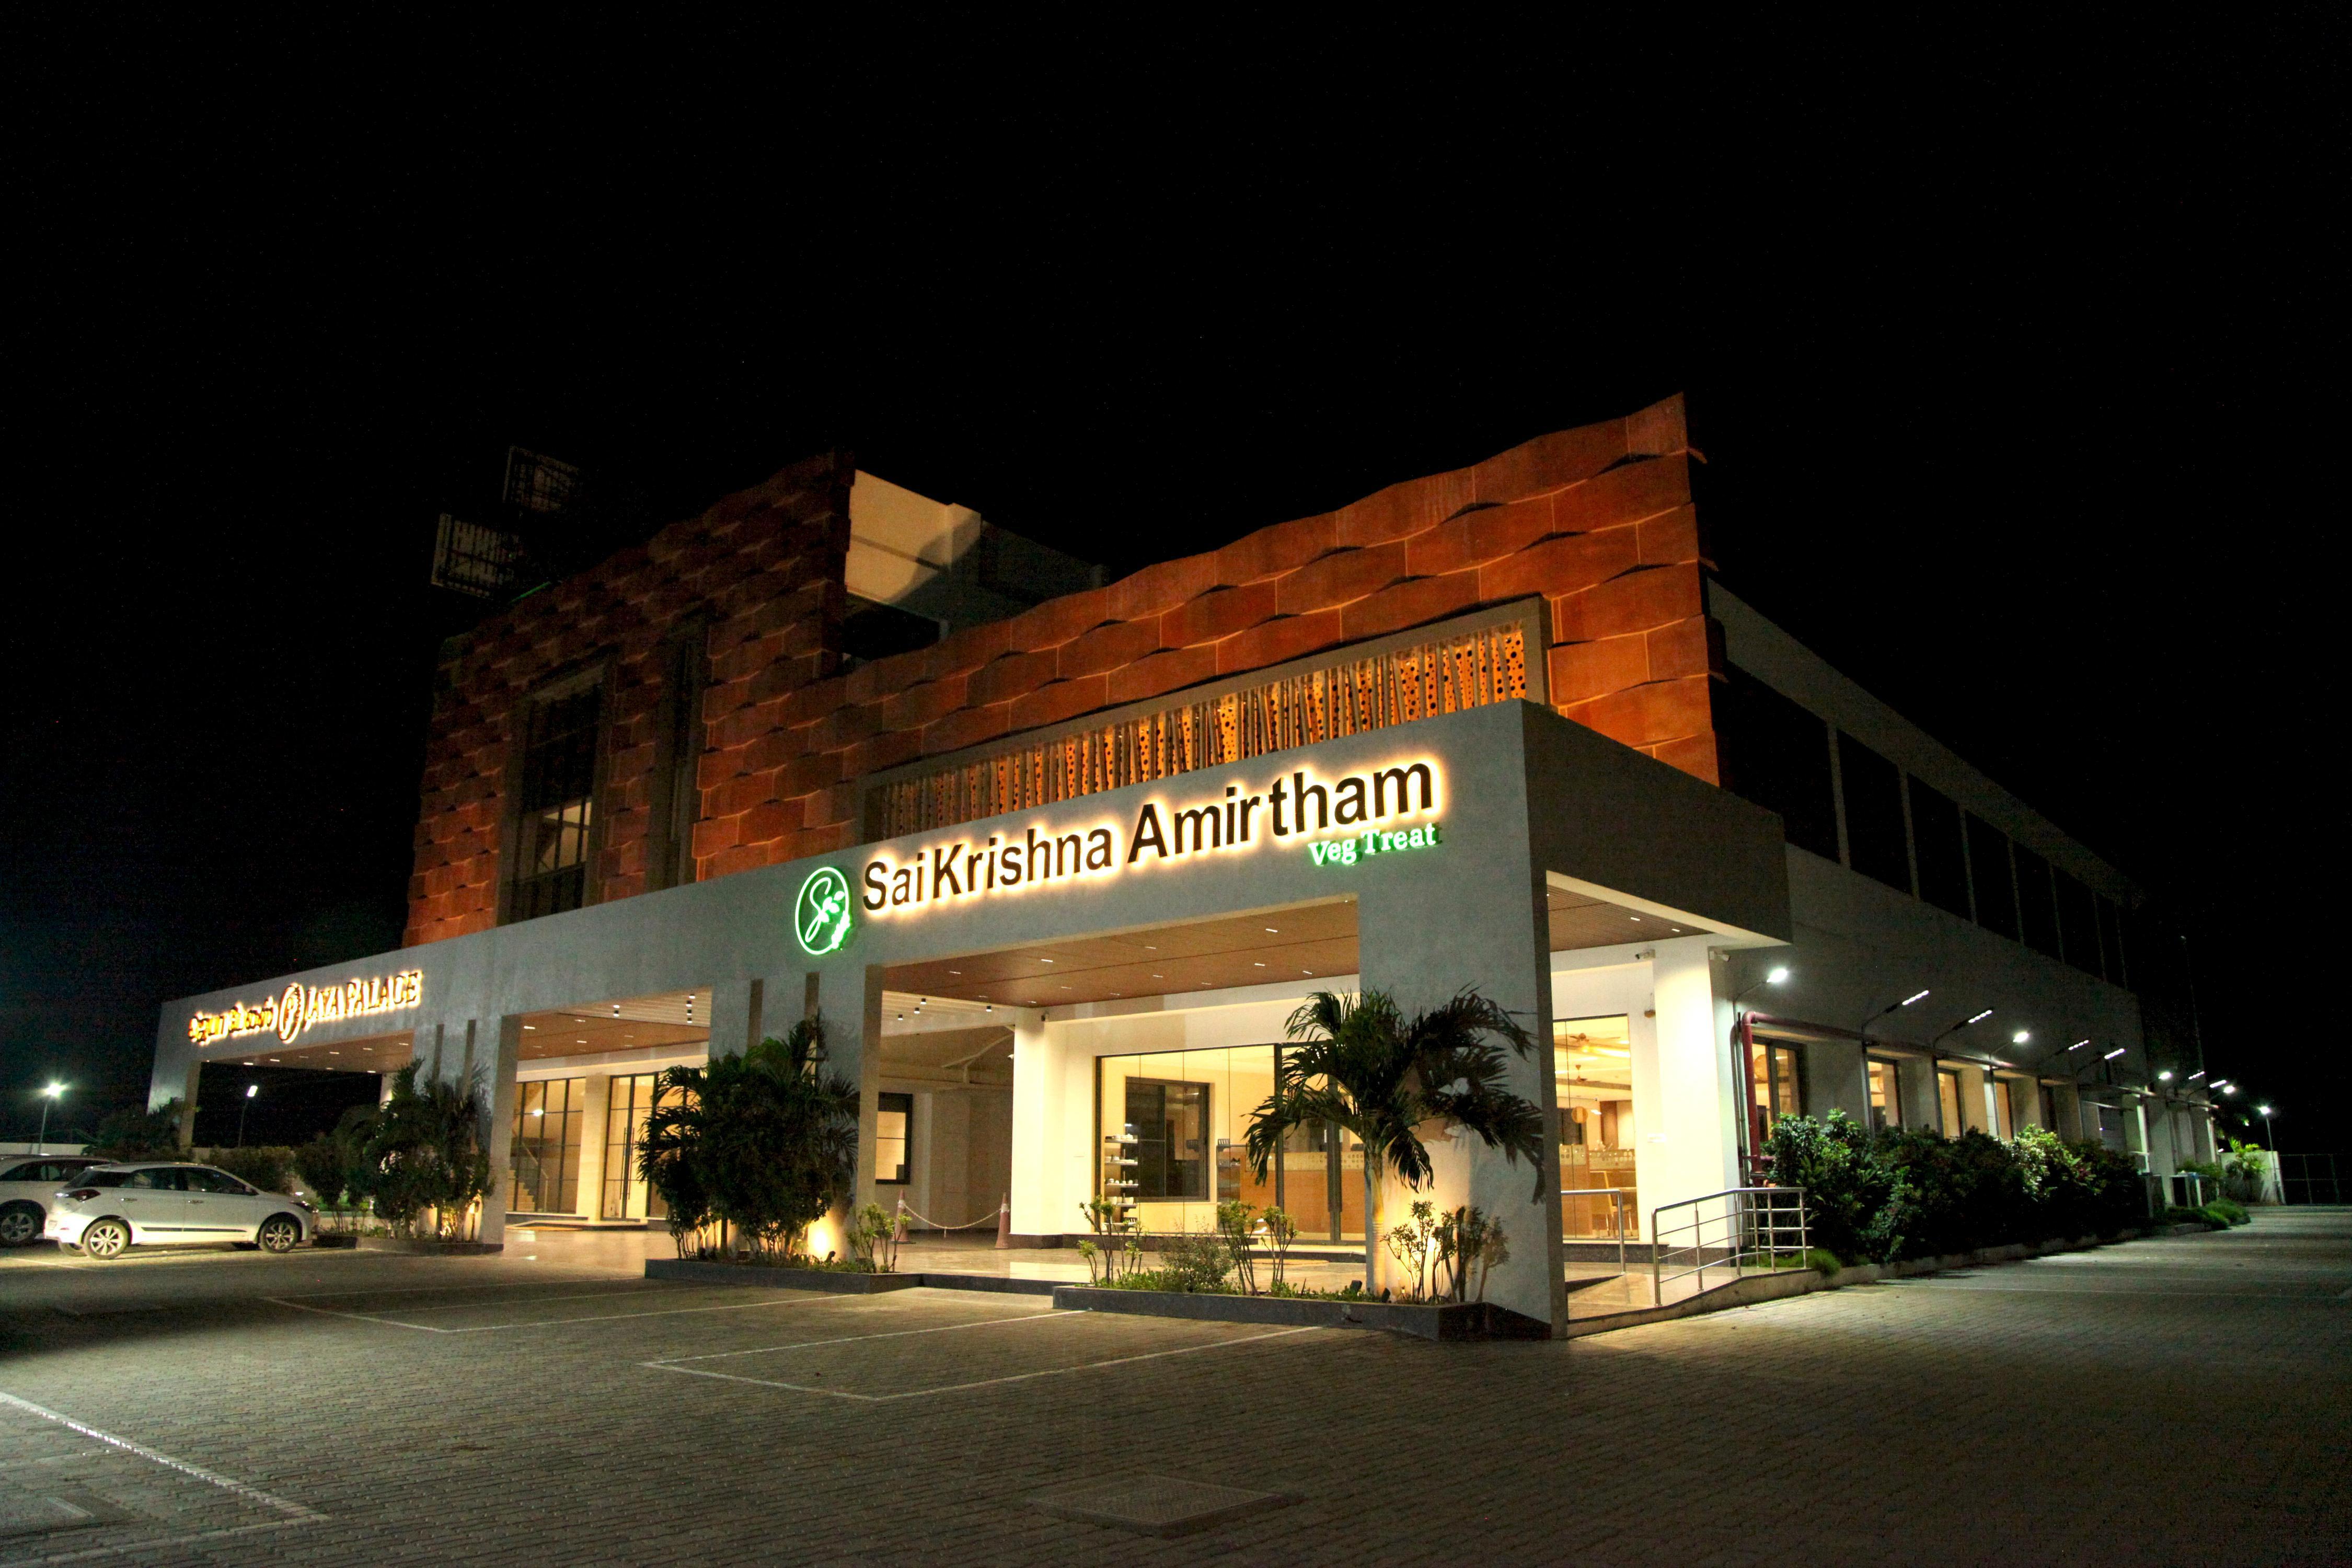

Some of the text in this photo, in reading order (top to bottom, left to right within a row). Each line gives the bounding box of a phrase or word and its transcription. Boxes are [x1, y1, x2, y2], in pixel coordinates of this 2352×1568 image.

[1127, 763, 1432, 863] Amirtham
[1308, 822, 1436, 866] Veg Treat
[344, 972, 421, 1016] PALACE
